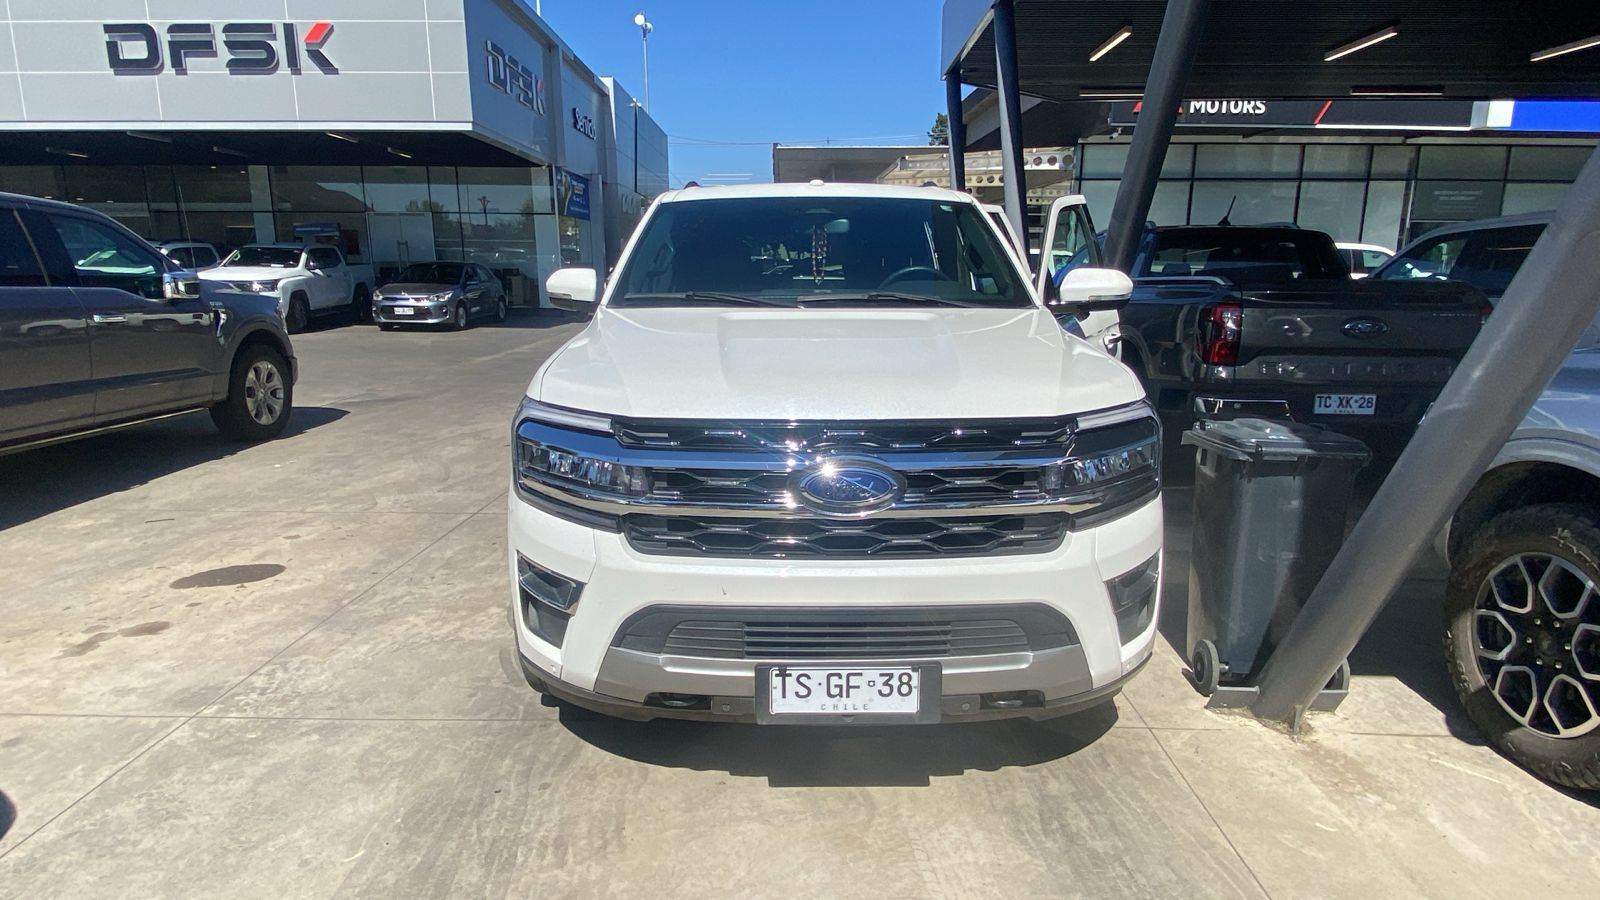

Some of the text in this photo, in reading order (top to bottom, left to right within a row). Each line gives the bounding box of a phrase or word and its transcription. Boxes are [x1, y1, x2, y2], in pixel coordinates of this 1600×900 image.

[103, 22, 339, 76] DFSK
[486, 39, 545, 117] DFSK
[1189, 100, 1267, 114] MOTORS
[820, 703, 870, 711] CHILE
